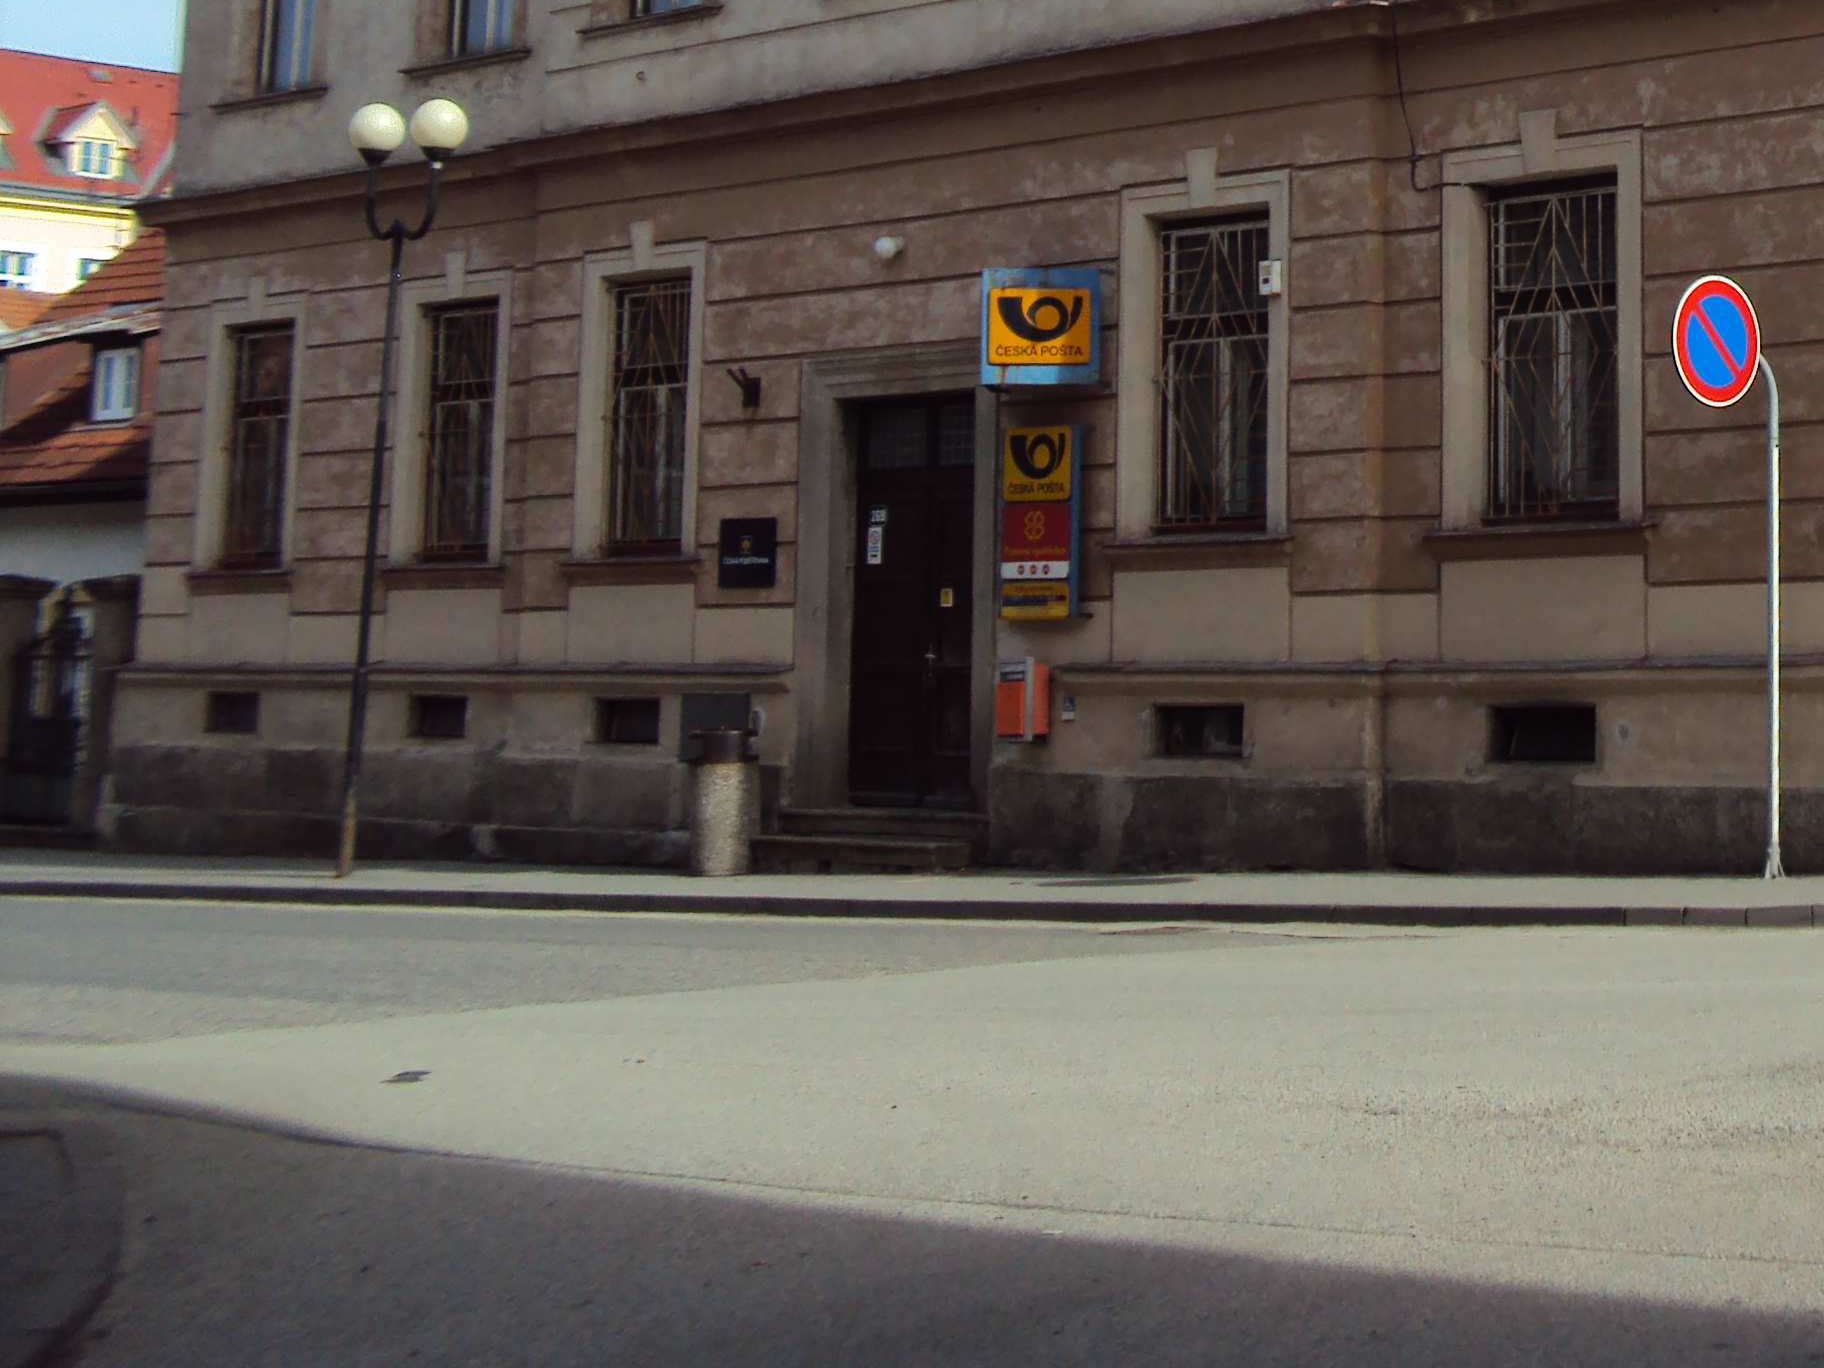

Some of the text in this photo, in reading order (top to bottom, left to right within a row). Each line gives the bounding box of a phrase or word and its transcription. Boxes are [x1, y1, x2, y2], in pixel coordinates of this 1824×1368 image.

[996, 343, 1083, 357] ČESKÁ POŠTA
[1037, 480, 1066, 493] POŠTA
